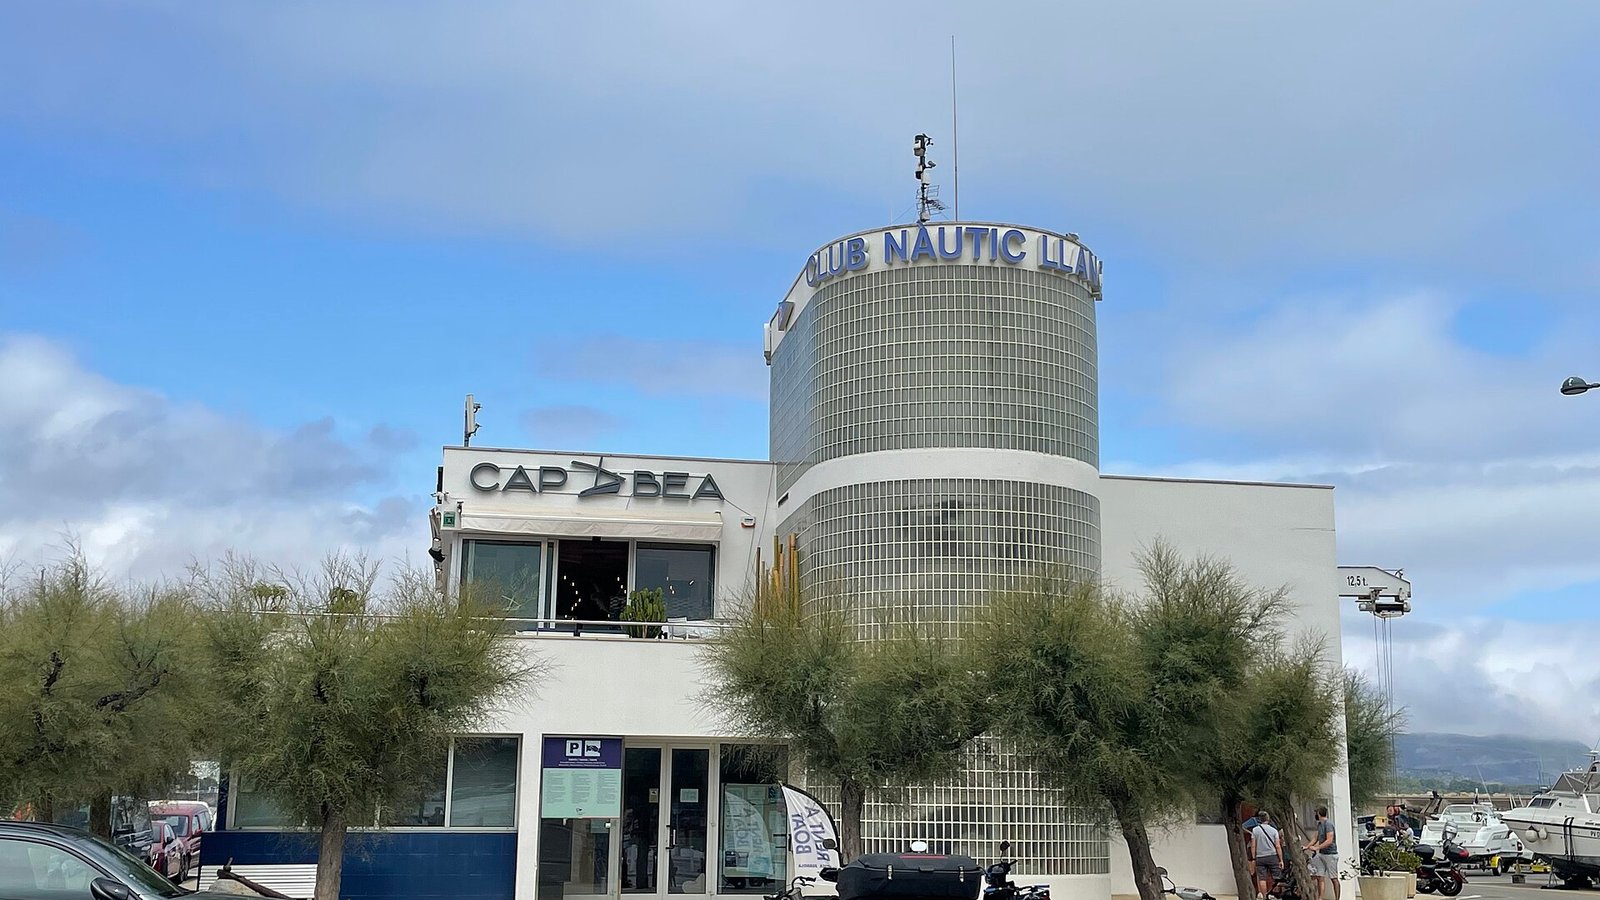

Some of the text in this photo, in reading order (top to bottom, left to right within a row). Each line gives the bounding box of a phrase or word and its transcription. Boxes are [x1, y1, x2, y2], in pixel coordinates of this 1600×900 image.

[806, 219, 1102, 290] CLUB NÀUTIC LLAN
[469, 462, 725, 500] CAP BEA
[1346, 575, 1361, 587] 12,5
